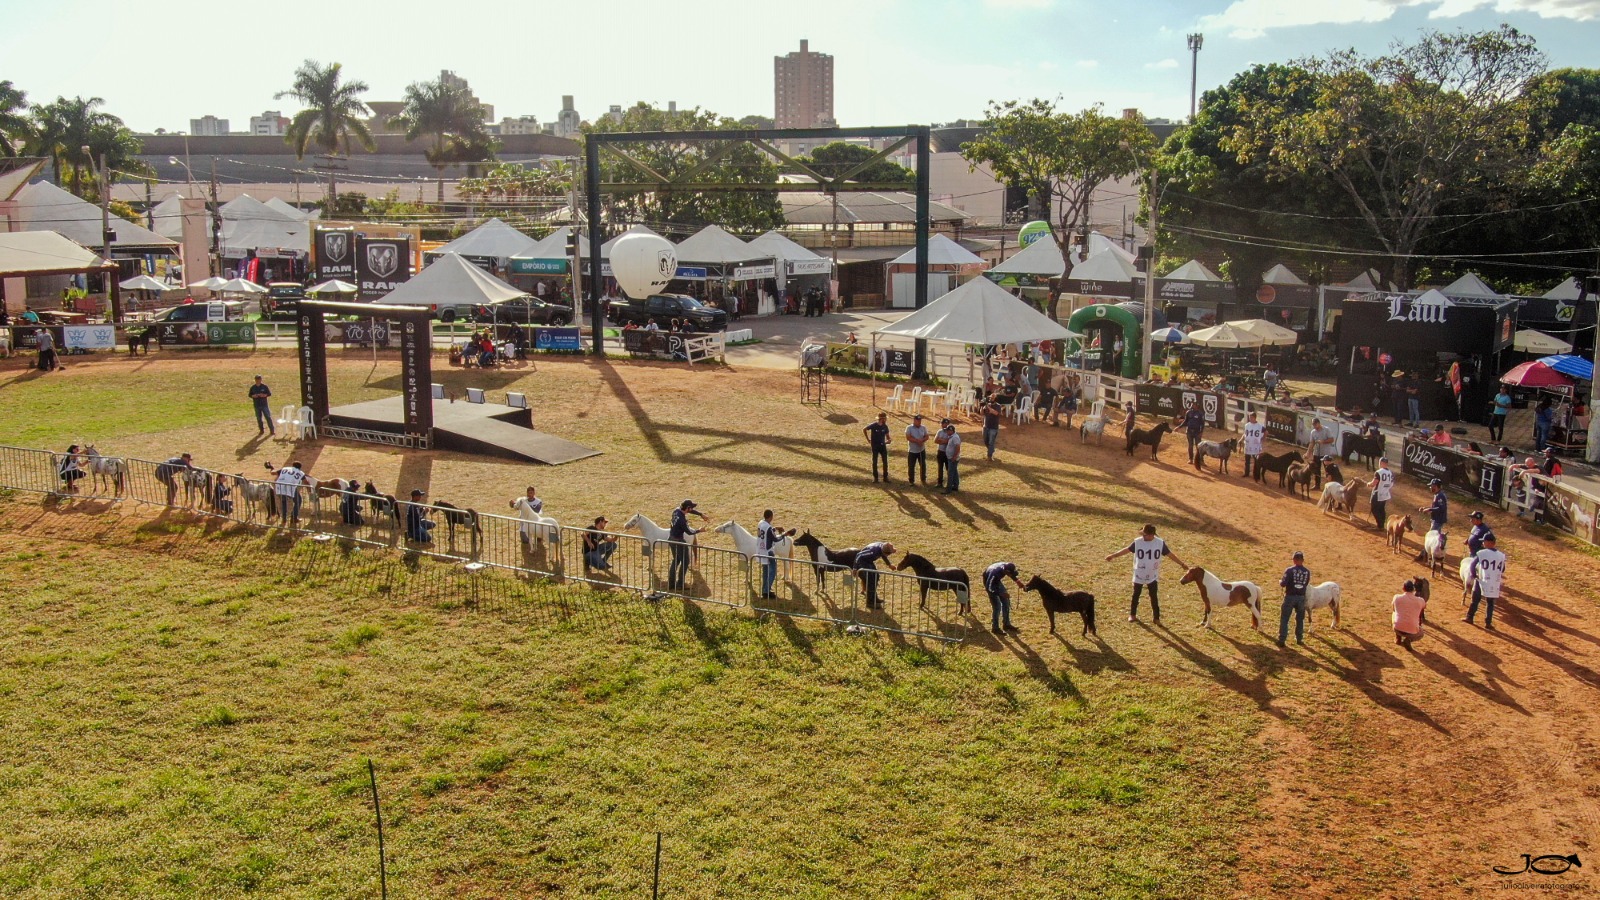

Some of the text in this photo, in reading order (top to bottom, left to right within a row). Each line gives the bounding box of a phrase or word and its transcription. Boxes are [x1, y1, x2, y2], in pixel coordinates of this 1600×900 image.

[322, 265, 351, 273] RAM
[522, 261, 546, 270] EMPÓRIO
[362, 281, 404, 290] RAM
[1384, 295, 1449, 323] Laut
[1137, 549, 1161, 560] 010
[1481, 559, 1504, 572] 014
